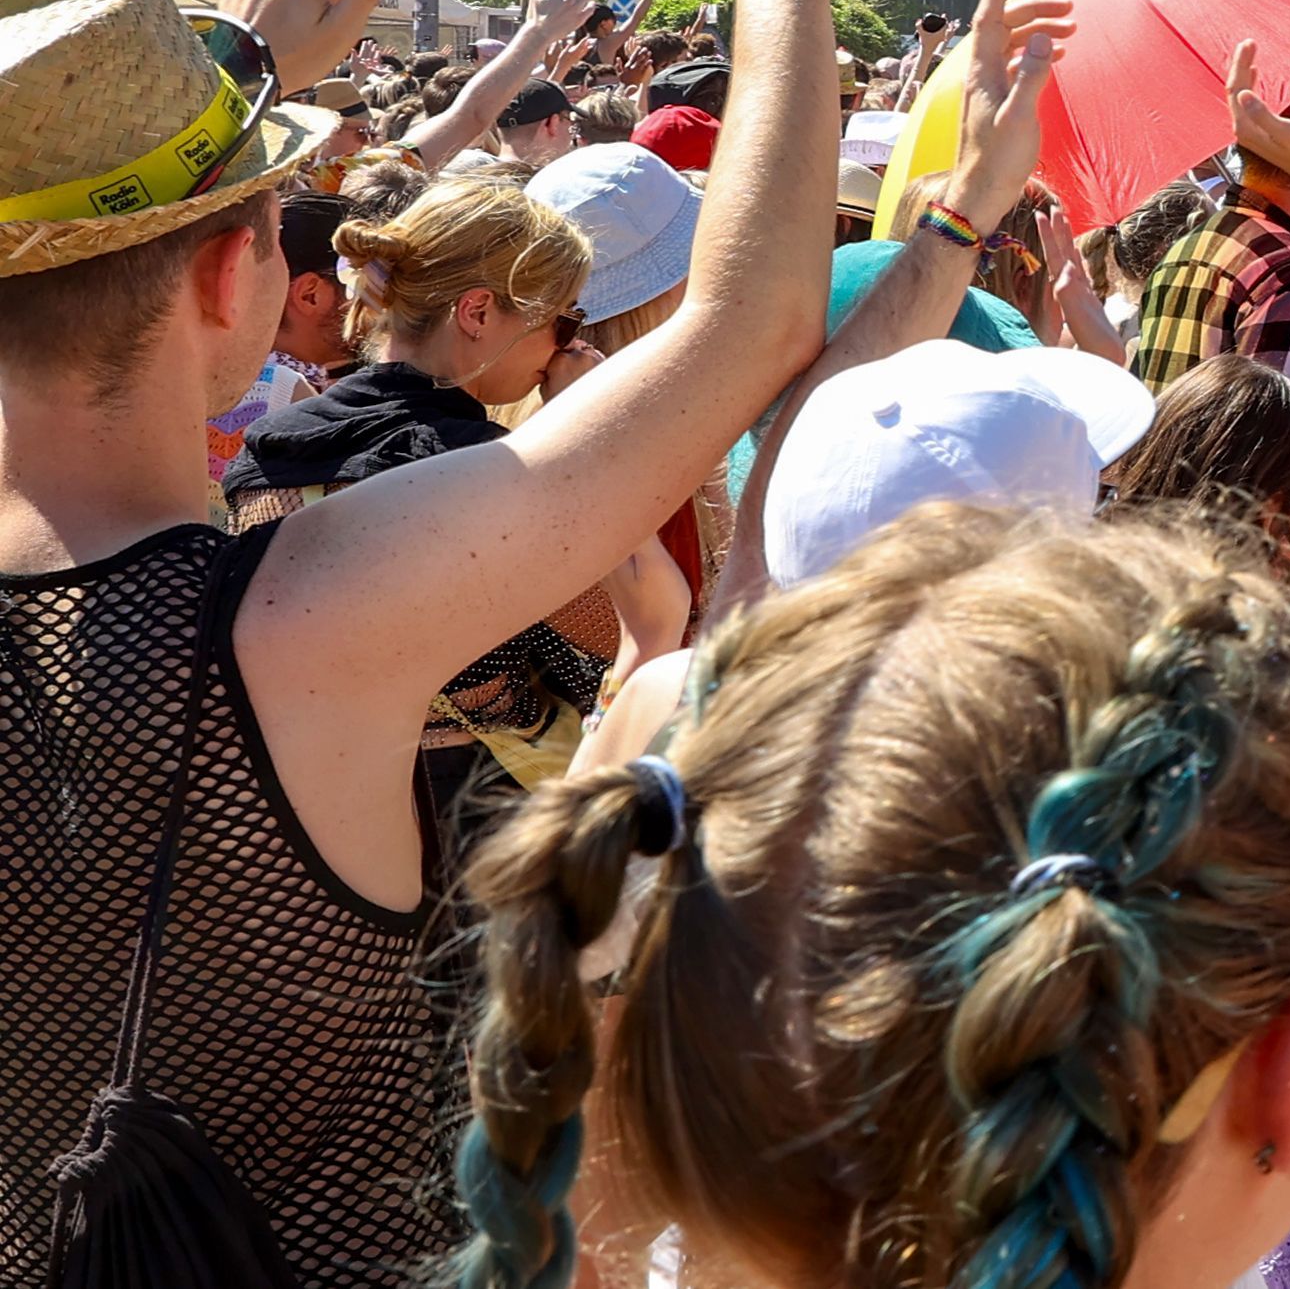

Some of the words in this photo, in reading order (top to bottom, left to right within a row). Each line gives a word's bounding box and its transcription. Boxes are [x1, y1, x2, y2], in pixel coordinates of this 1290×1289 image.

[184, 138, 210, 159] Radio
[193, 149, 216, 167] Köln
[99, 184, 137, 206] Radio
[109, 197, 140, 214] Köln
